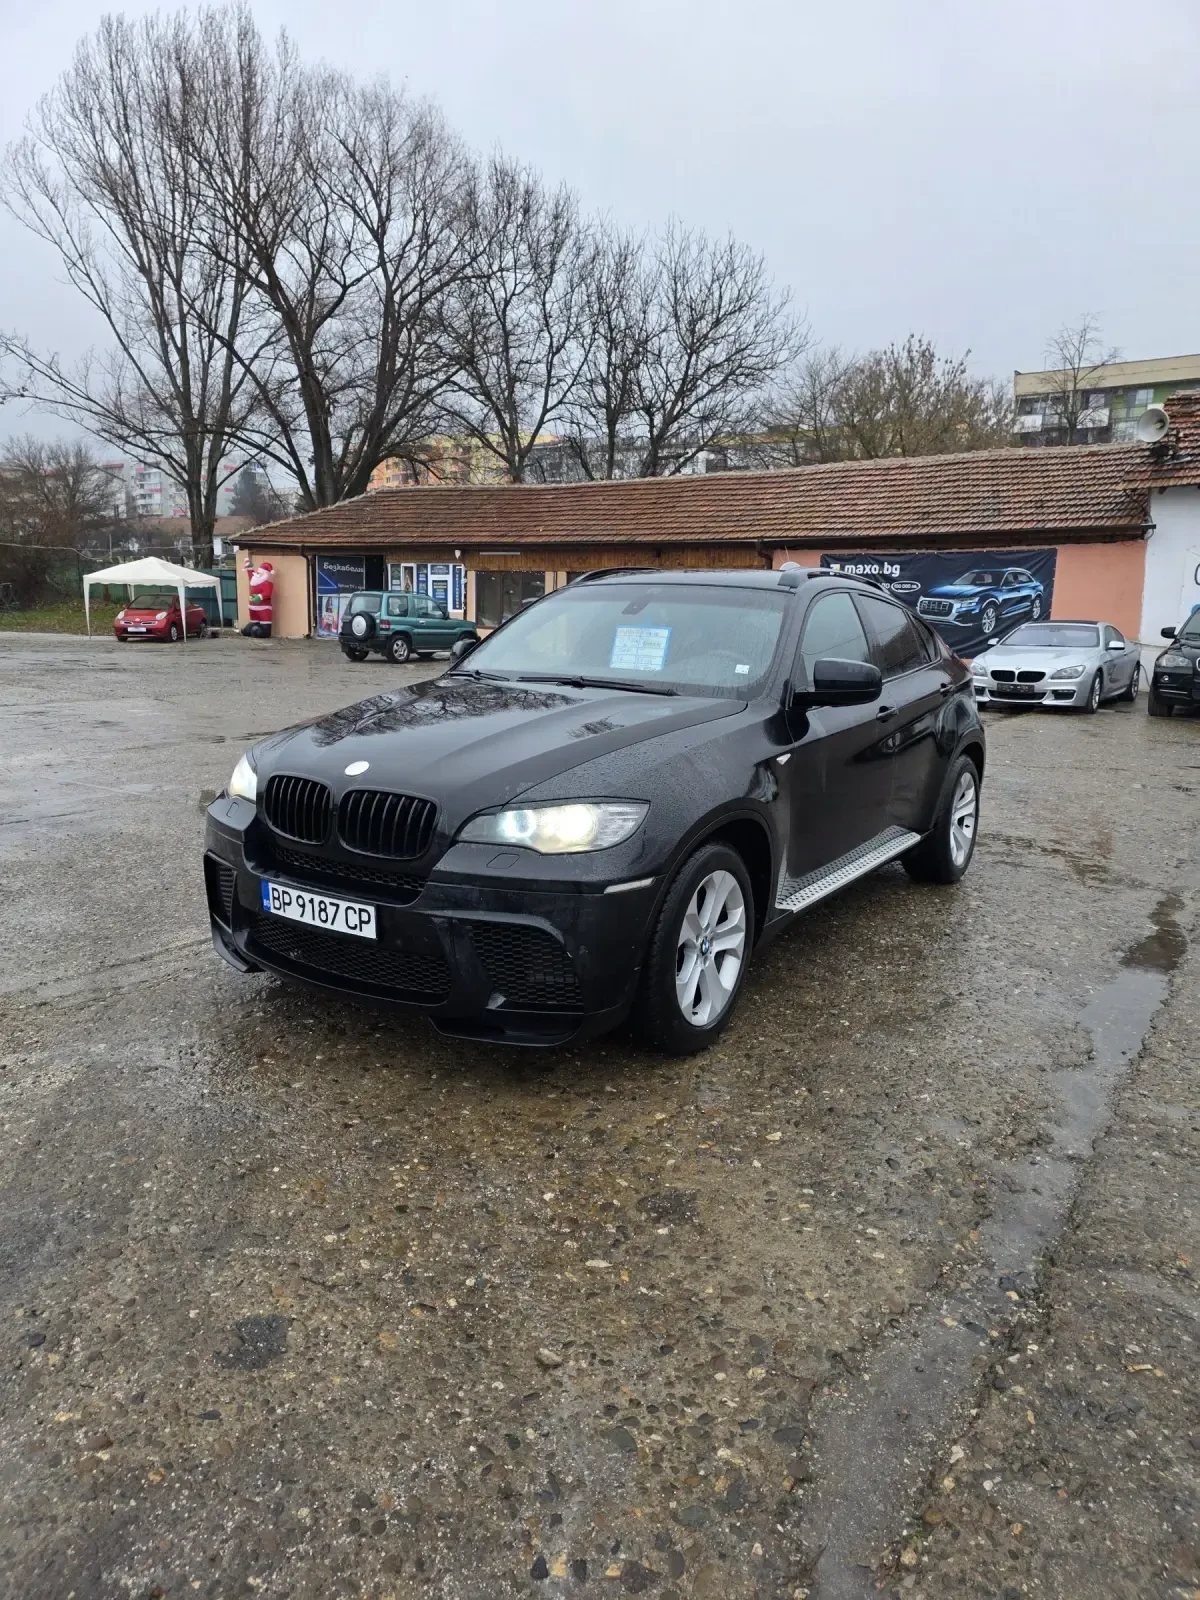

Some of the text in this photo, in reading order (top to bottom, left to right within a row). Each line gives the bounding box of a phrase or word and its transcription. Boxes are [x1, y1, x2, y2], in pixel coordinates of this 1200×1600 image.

[844, 562, 900, 577] maxo.bg
[271, 887, 371, 932] BP 9187 CP
